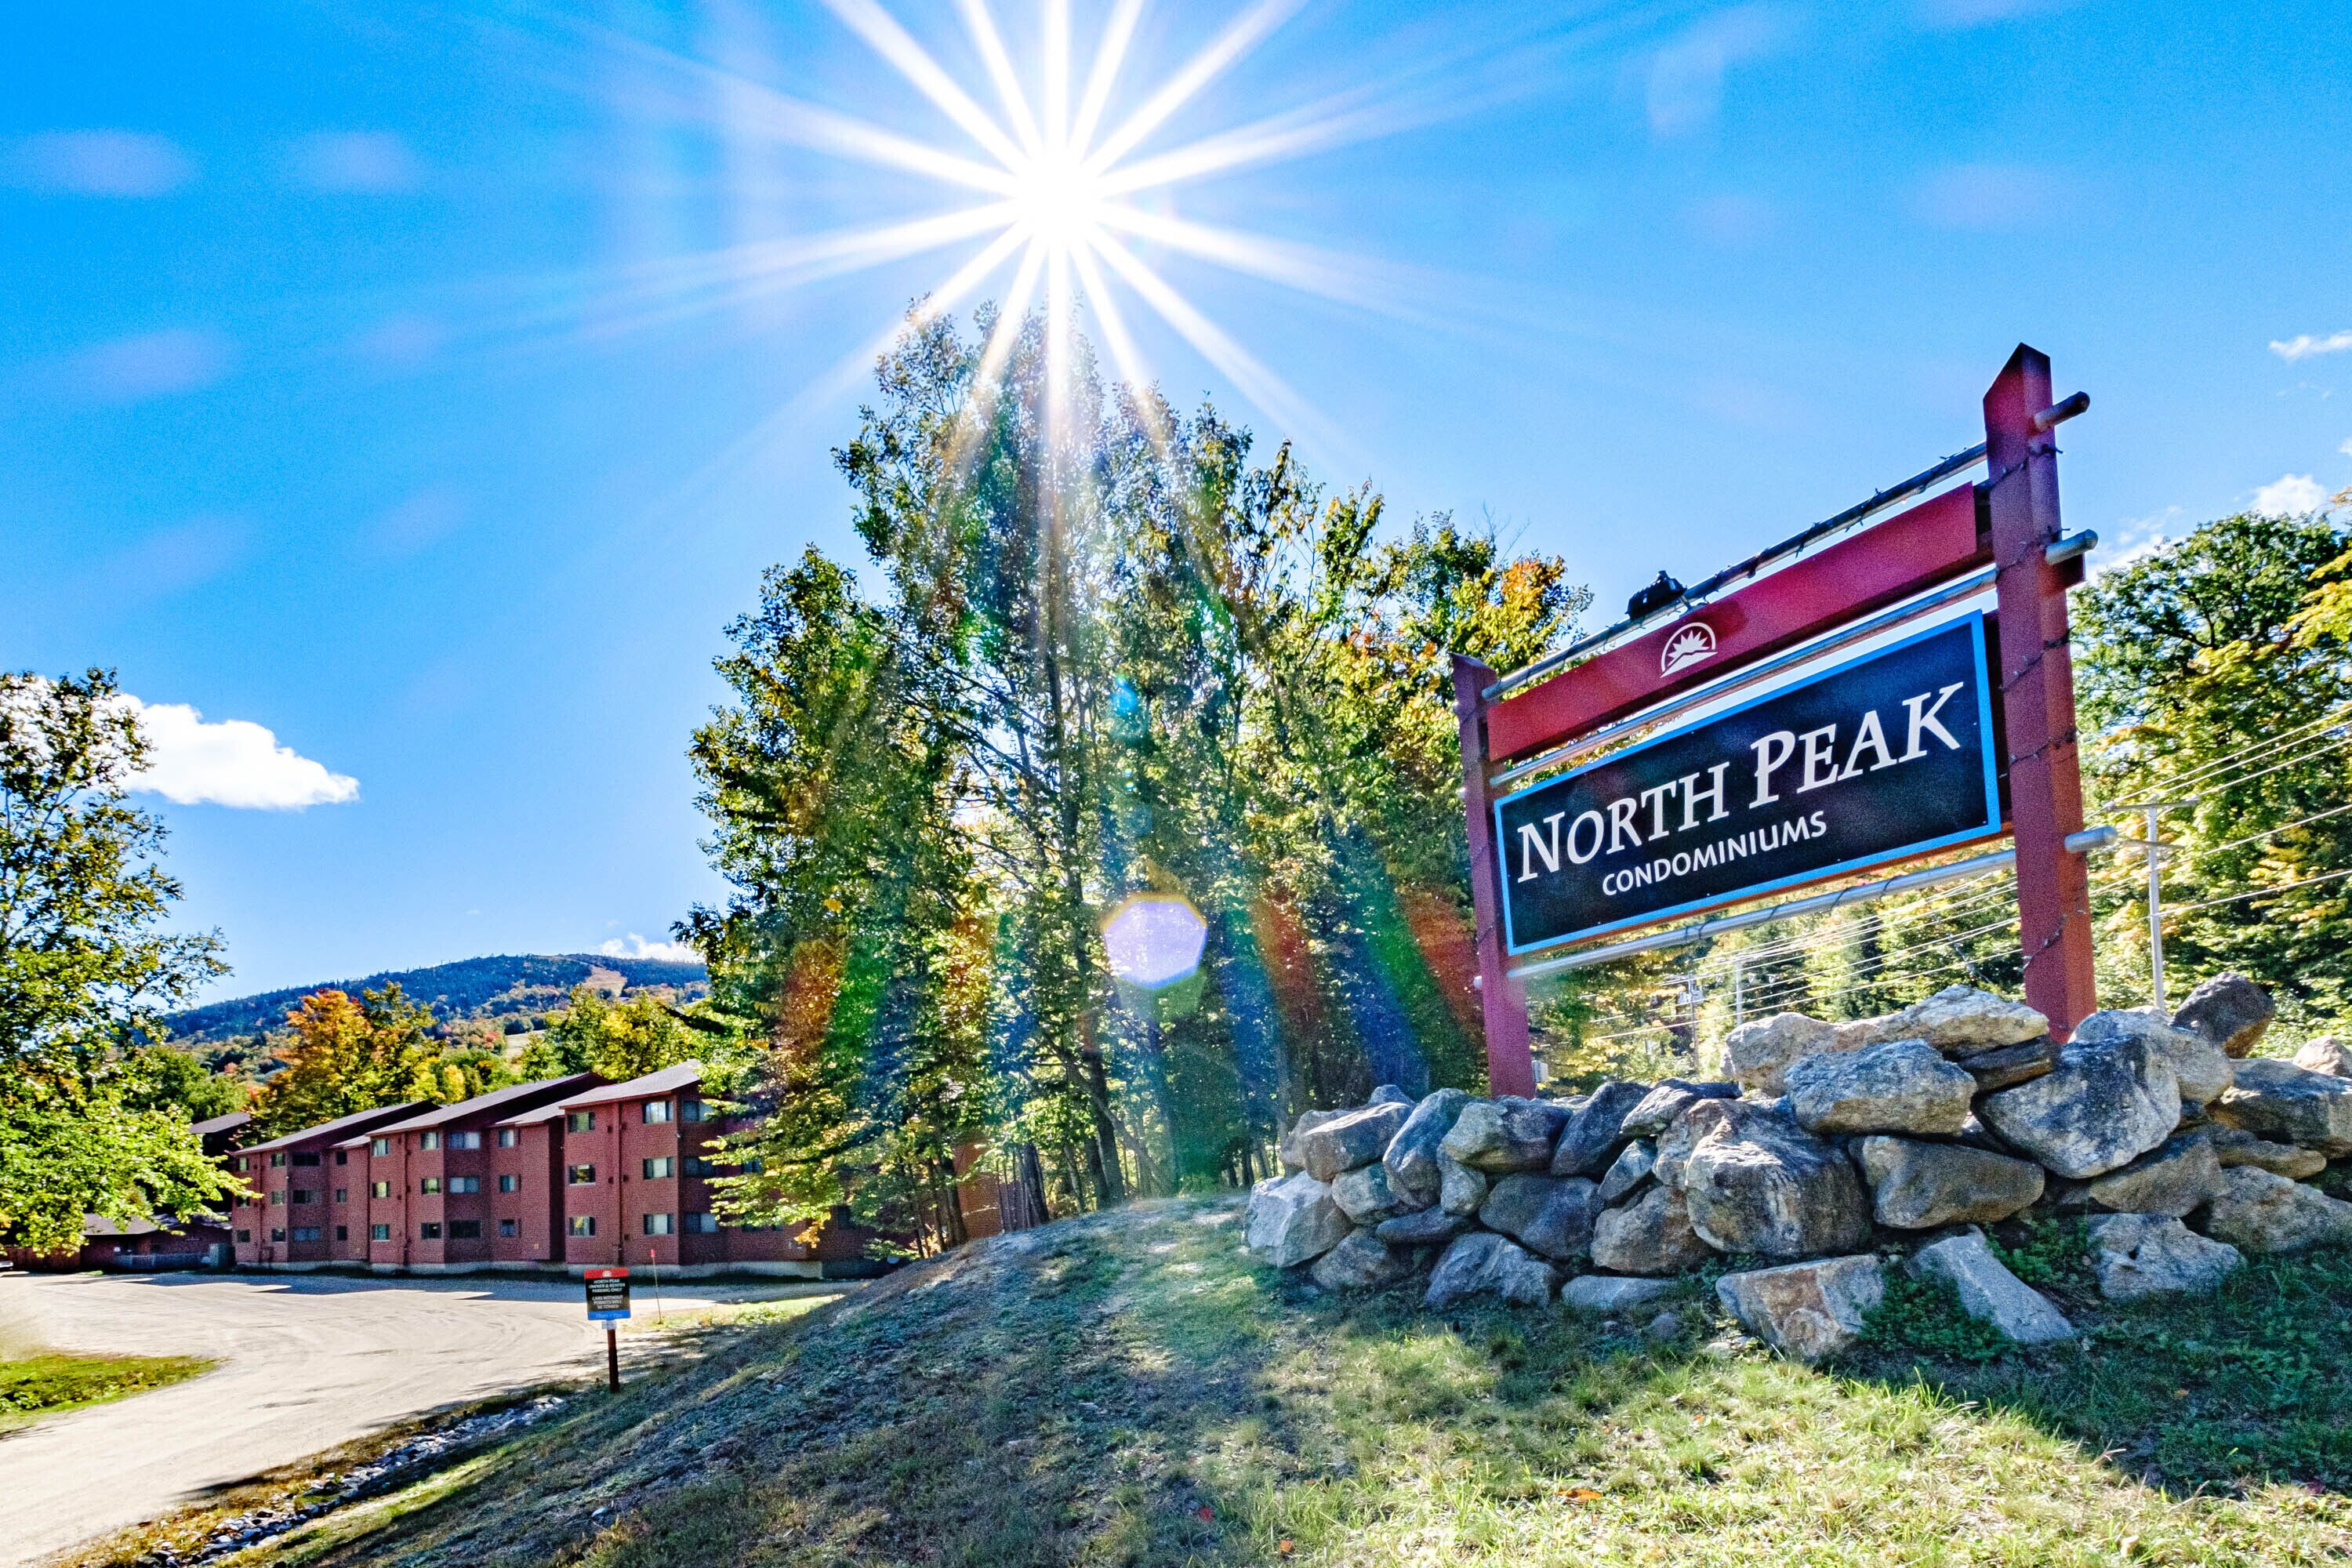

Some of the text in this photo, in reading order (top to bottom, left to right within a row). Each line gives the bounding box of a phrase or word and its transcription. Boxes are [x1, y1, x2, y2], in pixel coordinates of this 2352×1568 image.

[1517, 681, 1964, 883] NORTH PEAK
[1602, 811, 1827, 895] CONDOMINIUMS
